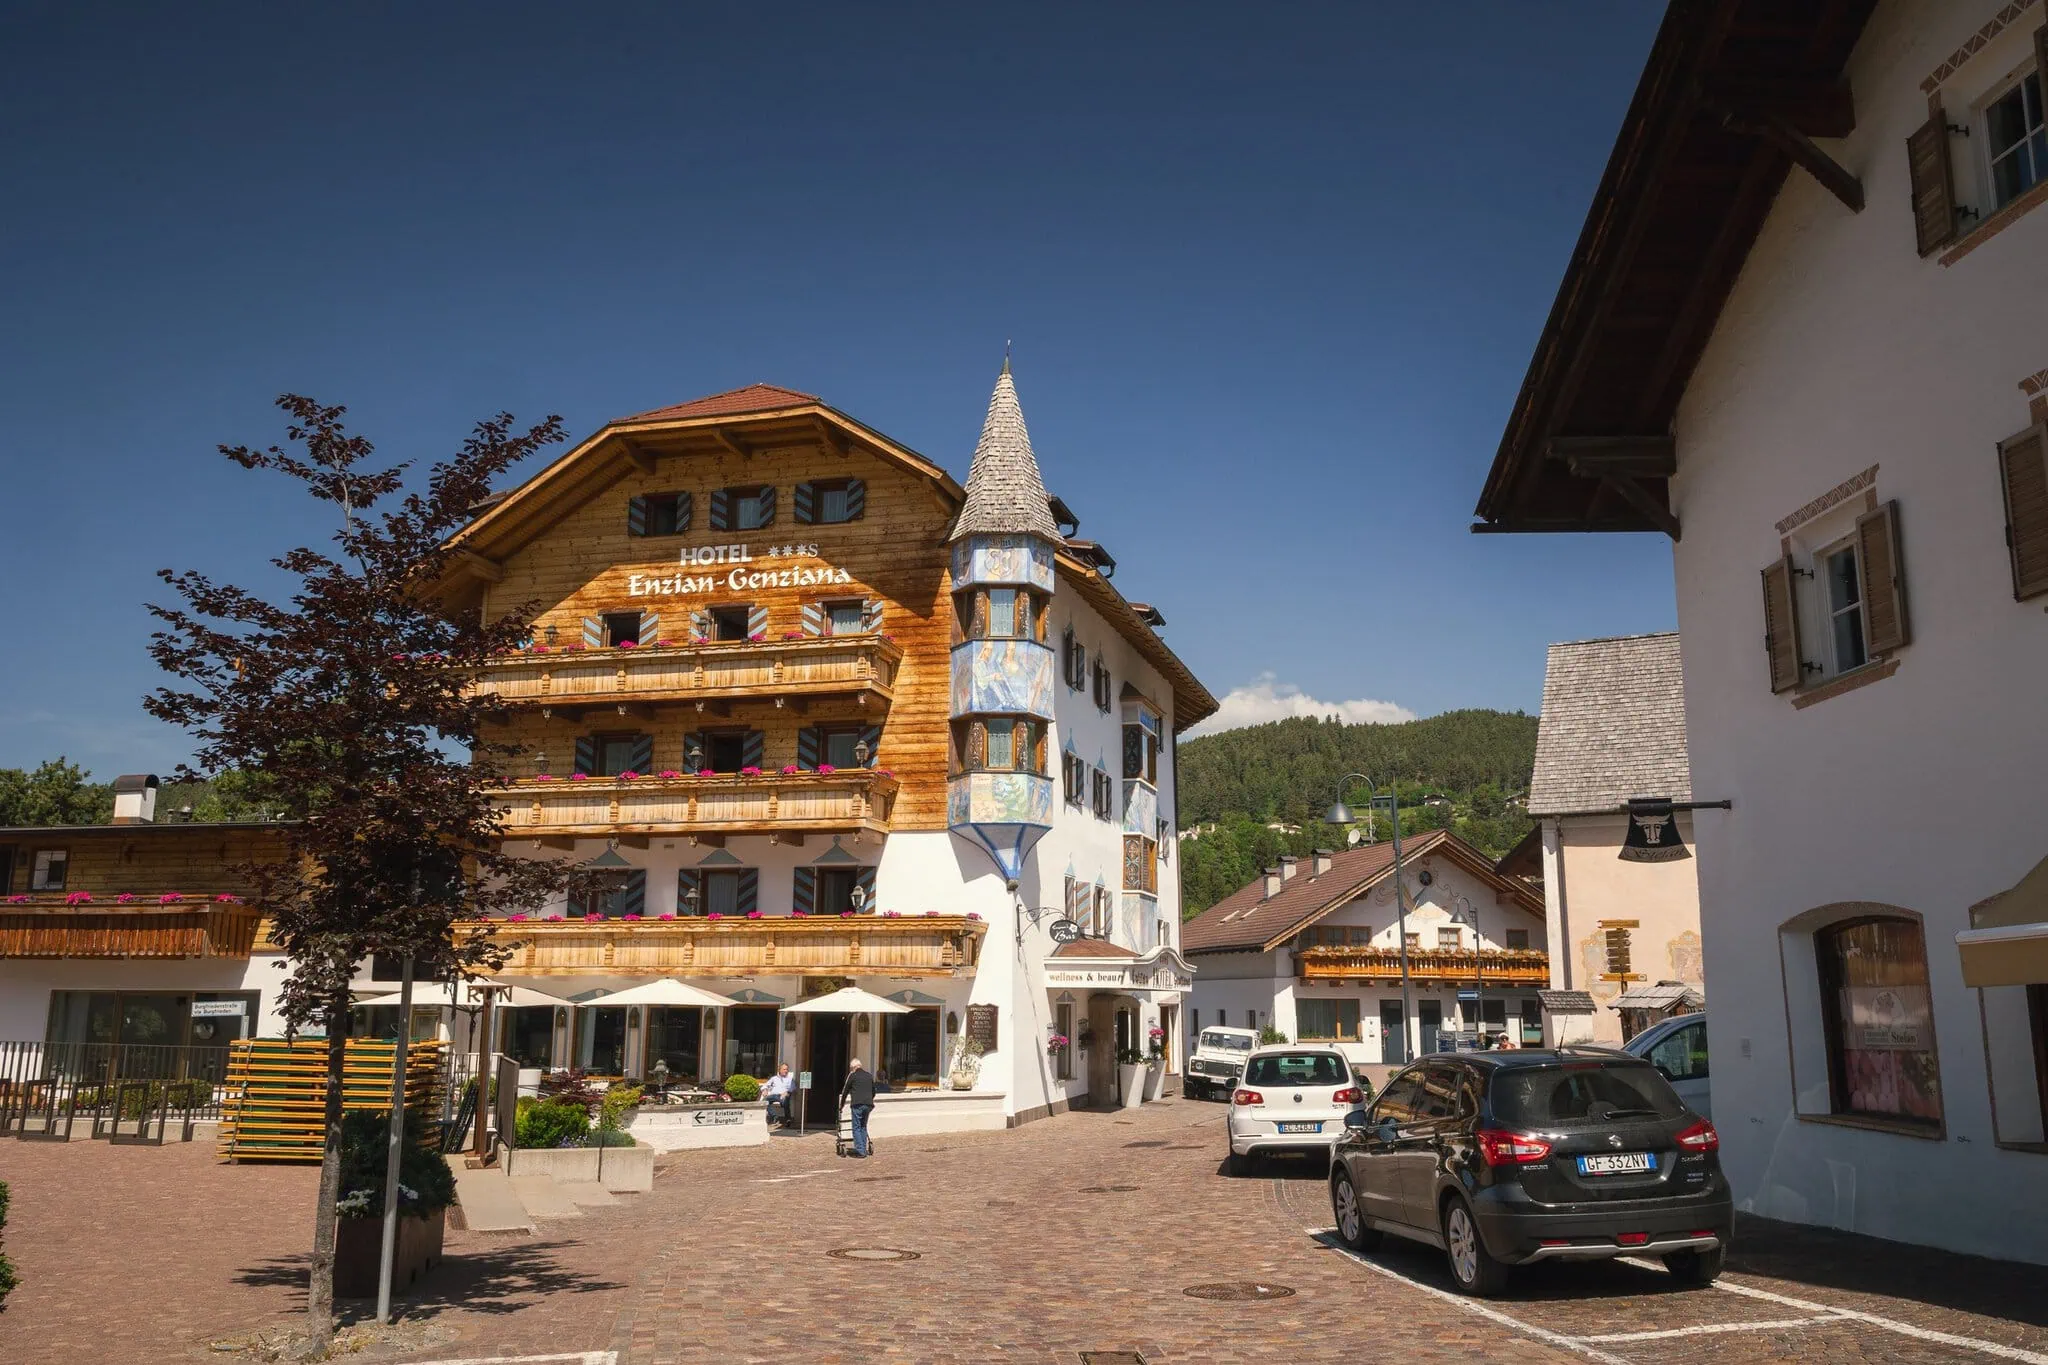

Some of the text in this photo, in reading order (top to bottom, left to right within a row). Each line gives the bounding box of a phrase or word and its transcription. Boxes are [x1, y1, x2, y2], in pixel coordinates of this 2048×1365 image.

[680, 544, 752, 566] HOTEL
[1049, 972, 1083, 982] wellness
[714, 1117, 739, 1125] Burghof
[1608, 1152, 1648, 1169] 332NV
